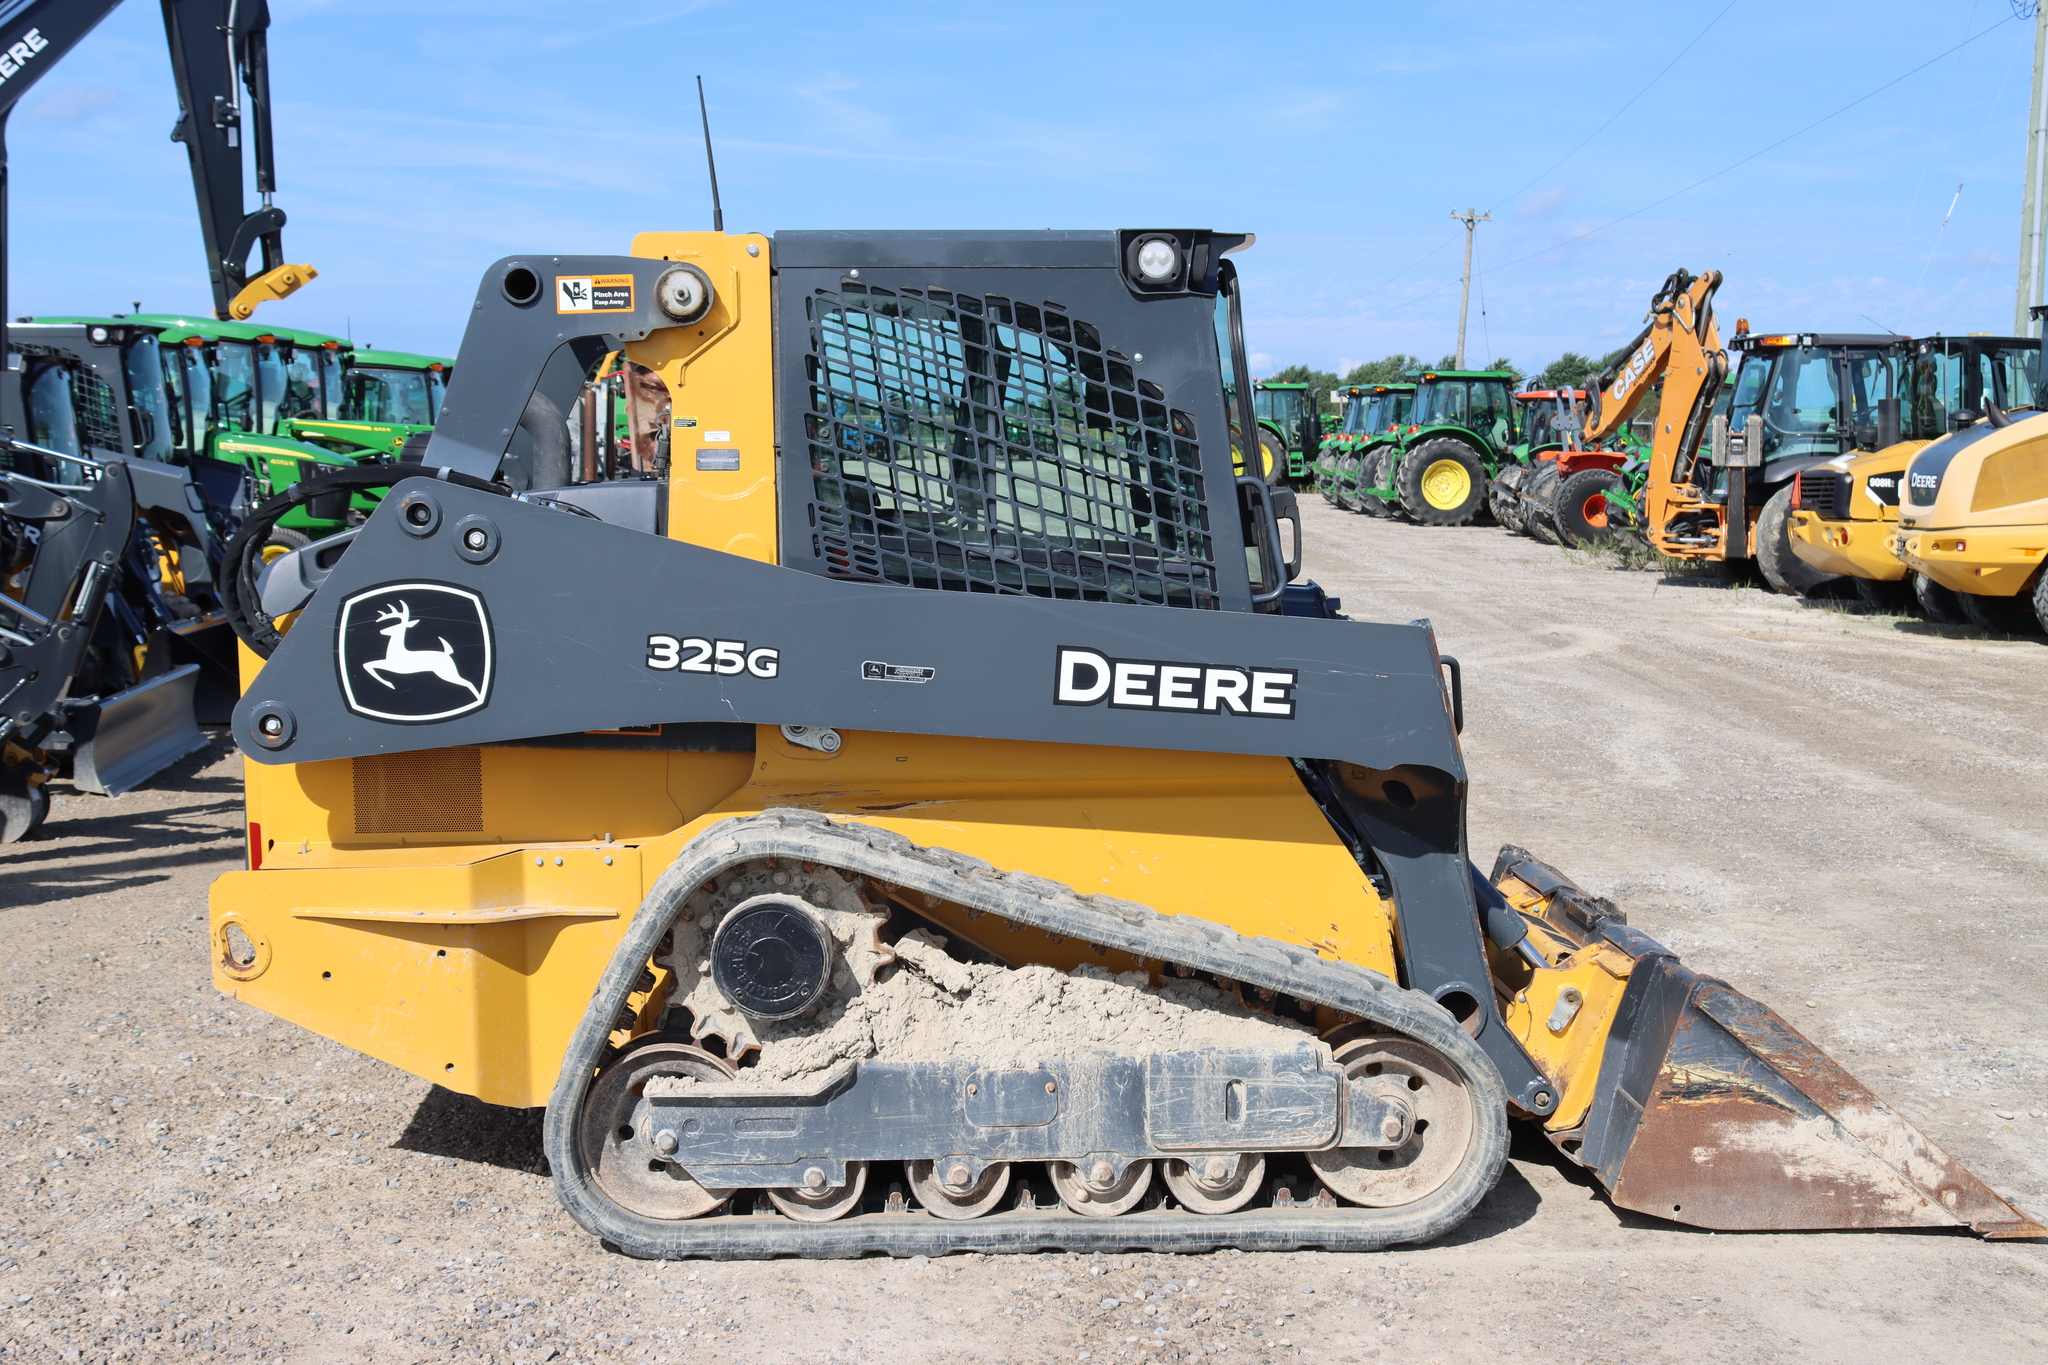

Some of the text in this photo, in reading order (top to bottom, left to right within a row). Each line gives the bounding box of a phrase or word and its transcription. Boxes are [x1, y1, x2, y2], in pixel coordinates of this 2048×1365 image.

[0, 27, 50, 86] ERE
[1613, 337, 1655, 400] CASE
[1911, 472, 1937, 488] DEERE
[646, 634, 780, 679] 325G
[1057, 648, 1295, 716] DEERE
